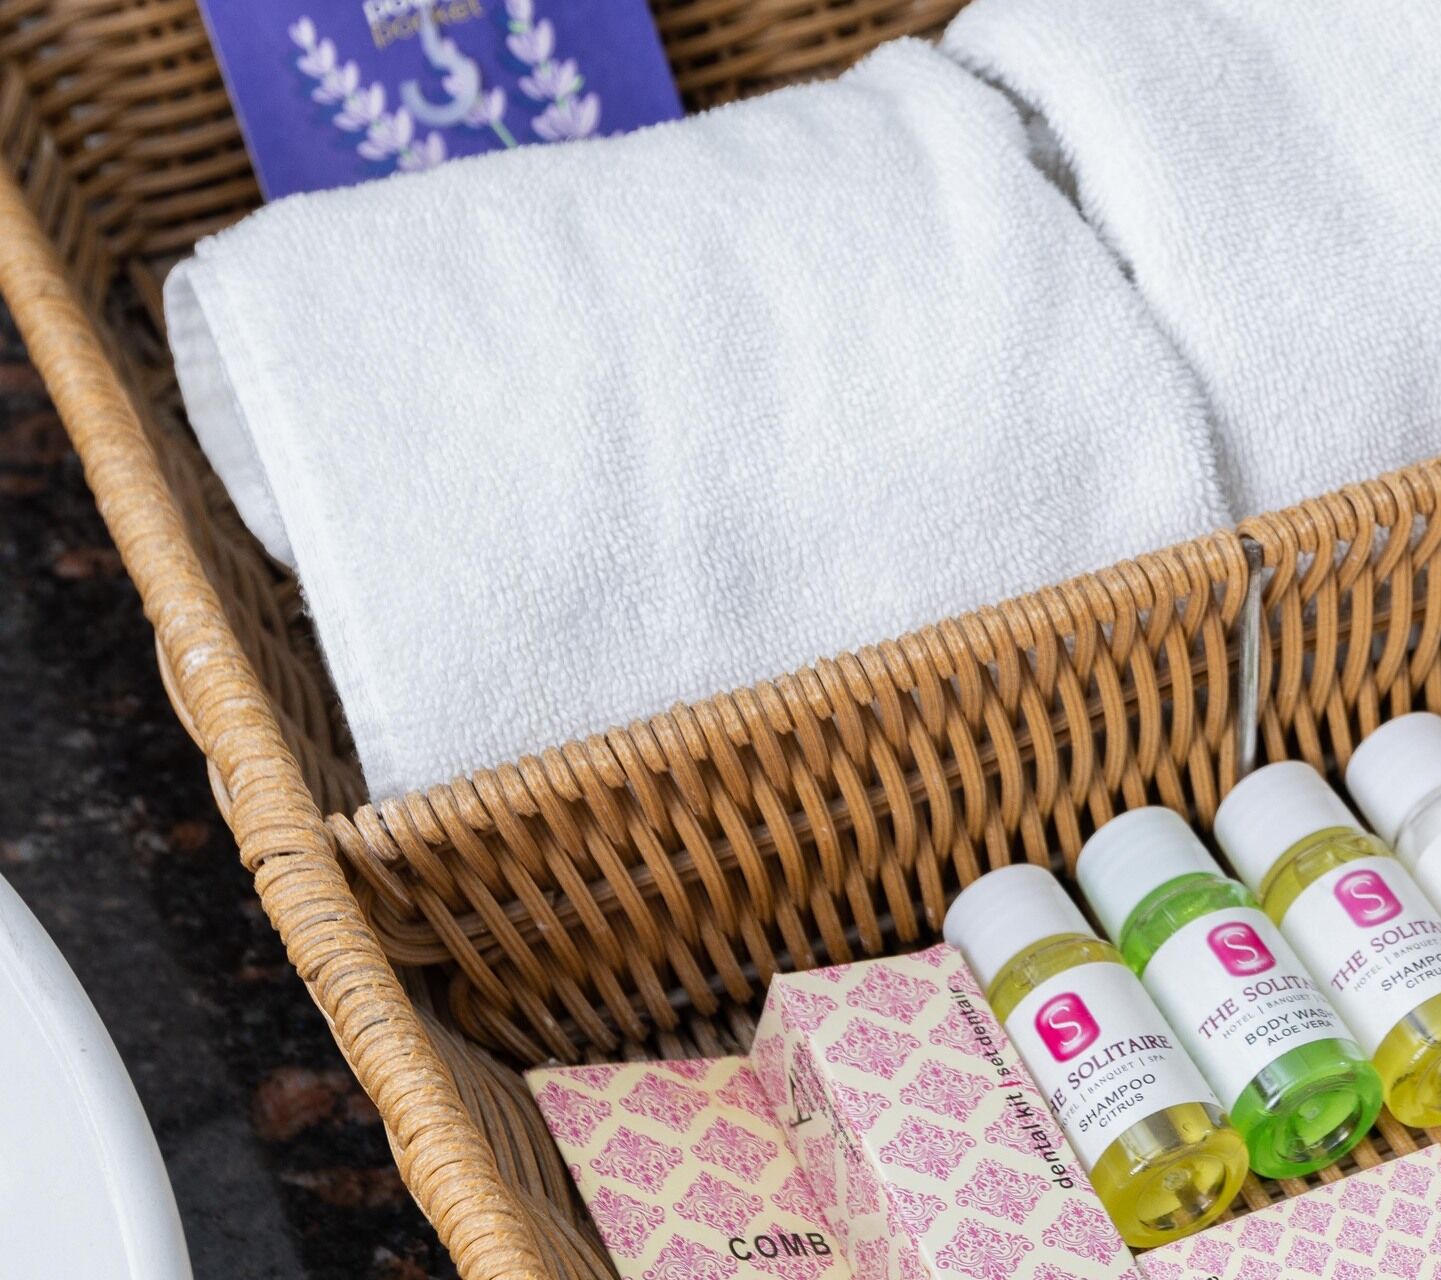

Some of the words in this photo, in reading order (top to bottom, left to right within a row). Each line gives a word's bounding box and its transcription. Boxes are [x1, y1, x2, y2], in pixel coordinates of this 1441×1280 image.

[1330, 950, 1368, 993] THE
[1199, 998, 1239, 1040] THE
[1222, 1011, 1254, 1039] HOTEL
[1245, 1013, 1289, 1046] BODY
[1267, 1023, 1300, 1046] ALOE
[1300, 1019, 1334, 1029] VERA
[1067, 1035, 1173, 1090] SOLITAIRE
[1087, 1061, 1135, 1095] BANQUET
[1005, 1091, 1035, 1119] kit
[1079, 1073, 1156, 1133] SHAMPOO
[1099, 1092, 1144, 1129] CITRUS
[1022, 1124, 1075, 1190] dental
[728, 1233, 831, 1261] COMB
